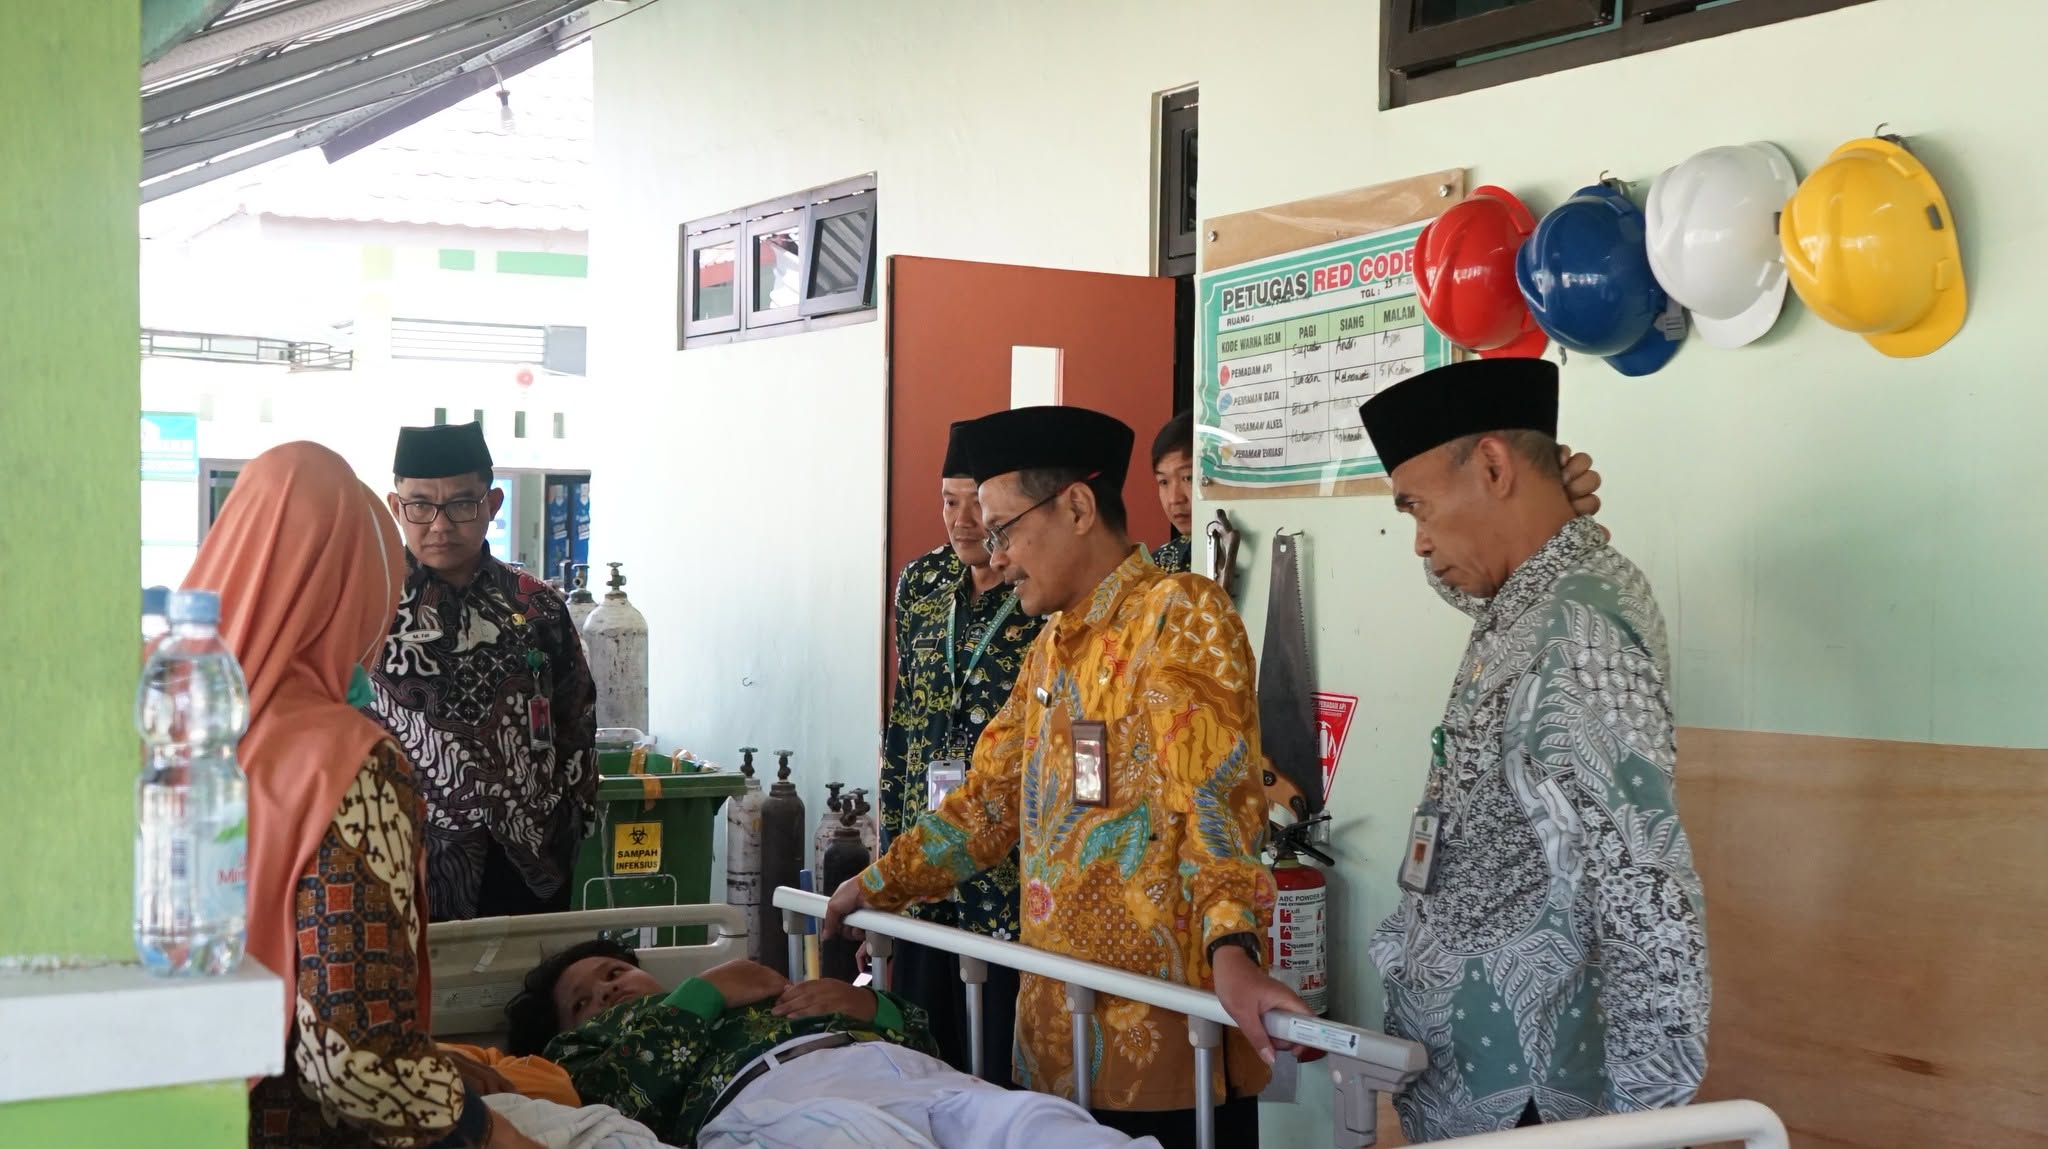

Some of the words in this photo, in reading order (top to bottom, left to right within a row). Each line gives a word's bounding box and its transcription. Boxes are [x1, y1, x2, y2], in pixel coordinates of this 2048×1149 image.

[1223, 273, 1307, 312] PETUGAS
[1313, 263, 1352, 292] RED
[1359, 249, 1415, 282] CODE
[1361, 290, 1375, 299] TGL
[1383, 306, 1416, 323] MALAM
[1226, 315, 1250, 326] RUANG
[1340, 316, 1364, 331] SIANG
[1299, 325, 1316, 339] PAGI
[1221, 340, 1238, 353] KODE
[1240, 336, 1262, 350] WARNA
[1264, 331, 1281, 345] HELM
[1231, 365, 1261, 379] PEMADAM
[1262, 363, 1273, 374] API
[1264, 391, 1280, 402] DATA
[617, 850, 658, 858] SAMPAH
[616, 861, 658, 870] INFEKSIUS
[1279, 895, 1294, 903] ABC
[1284, 908, 1300, 917] Pull
[1284, 926, 1300, 935] Aim
